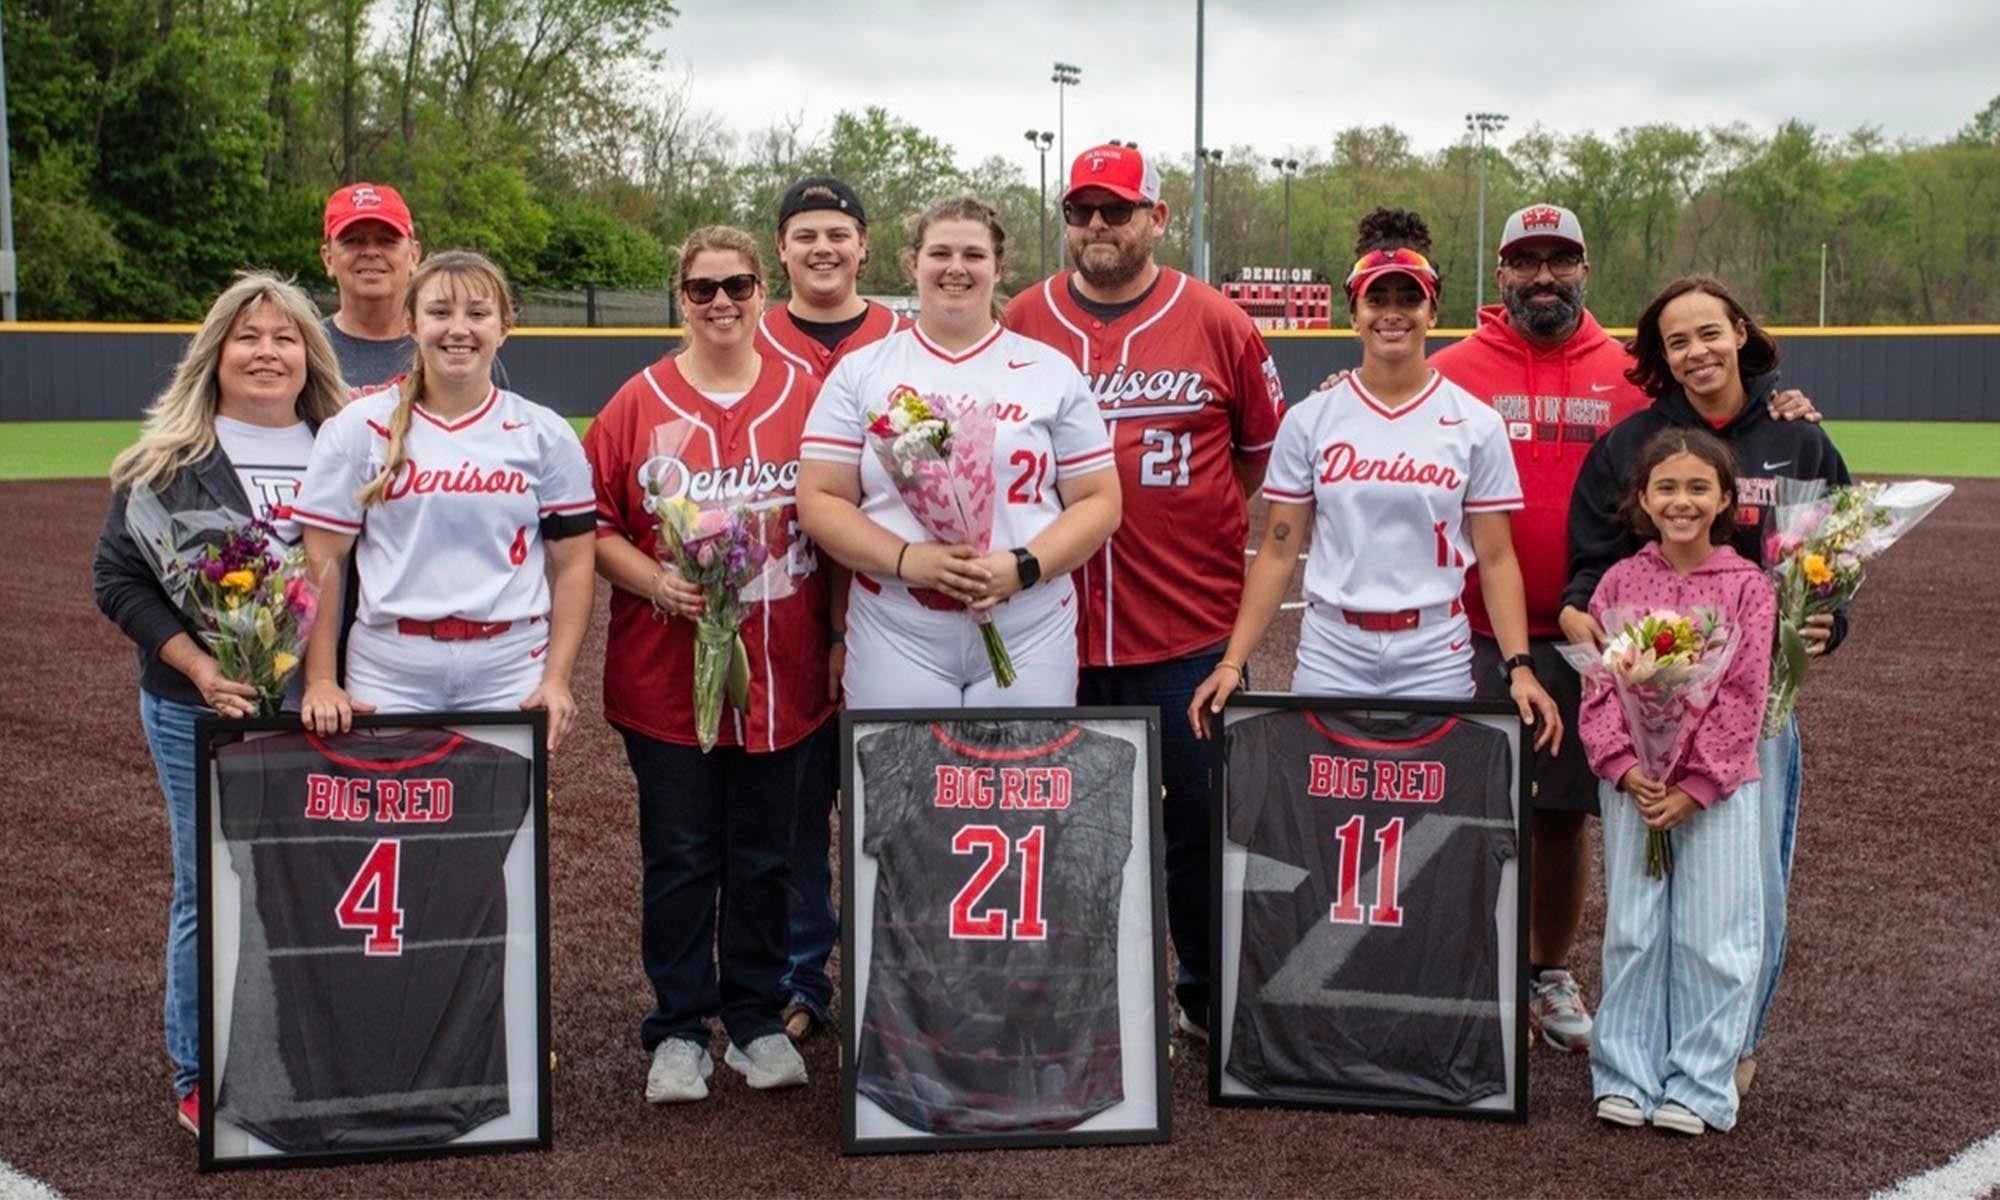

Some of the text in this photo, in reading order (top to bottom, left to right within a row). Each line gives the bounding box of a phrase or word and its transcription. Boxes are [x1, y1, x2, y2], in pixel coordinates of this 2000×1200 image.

[1088, 364, 1213, 404] nison
[381, 458, 529, 501] Denison
[1007, 450, 1048, 504] 21
[1140, 428, 1192, 487] 21
[1320, 442, 1461, 490] Denison
[637, 455, 800, 514] Deniso
[304, 773, 454, 823] BIG RED
[933, 764, 1072, 810] BIG RED
[1308, 754, 1446, 803] BIG RED
[334, 838, 405, 956] 4
[949, 824, 1047, 940] 21
[1330, 815, 1404, 927] 11
